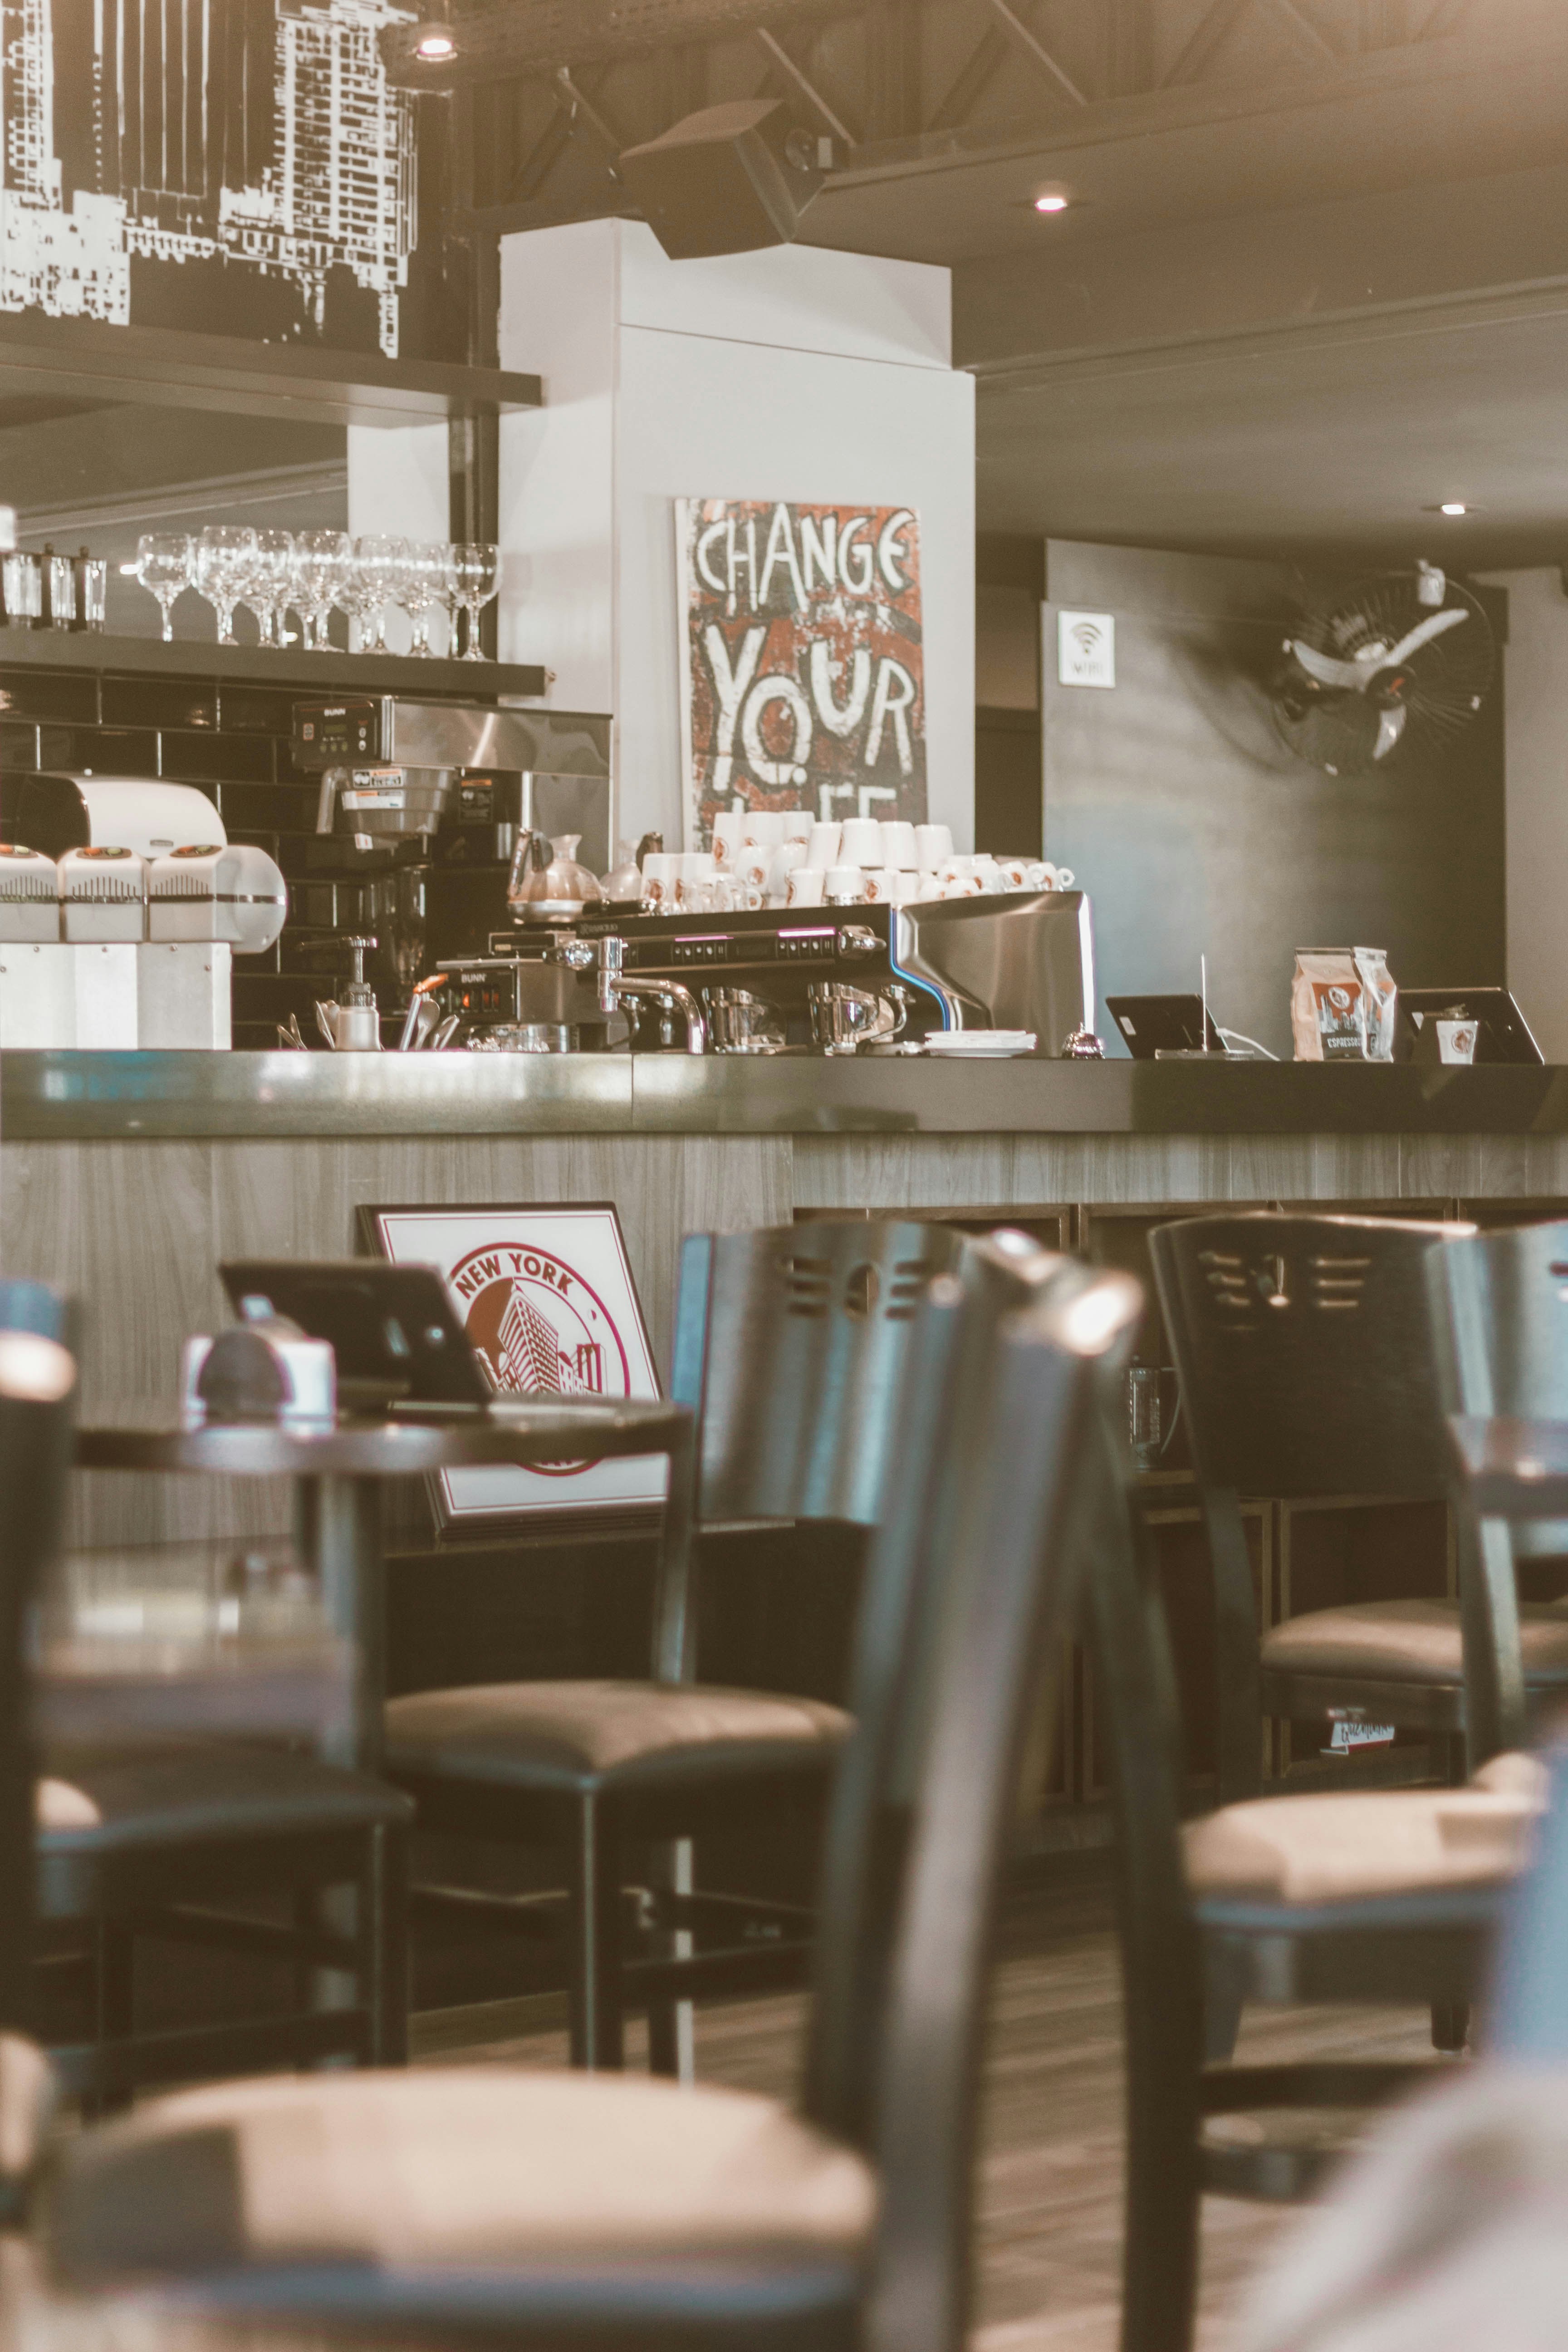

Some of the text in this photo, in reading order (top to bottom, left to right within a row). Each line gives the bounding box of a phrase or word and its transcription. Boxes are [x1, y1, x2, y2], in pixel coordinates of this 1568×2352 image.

[698, 503, 914, 615] CHANGE
[324, 708, 346, 716] BUNN
[703, 625, 913, 792] YOUR
[461, 973, 486, 983] BUNN
[456, 1253, 574, 1299] NEW YORK
